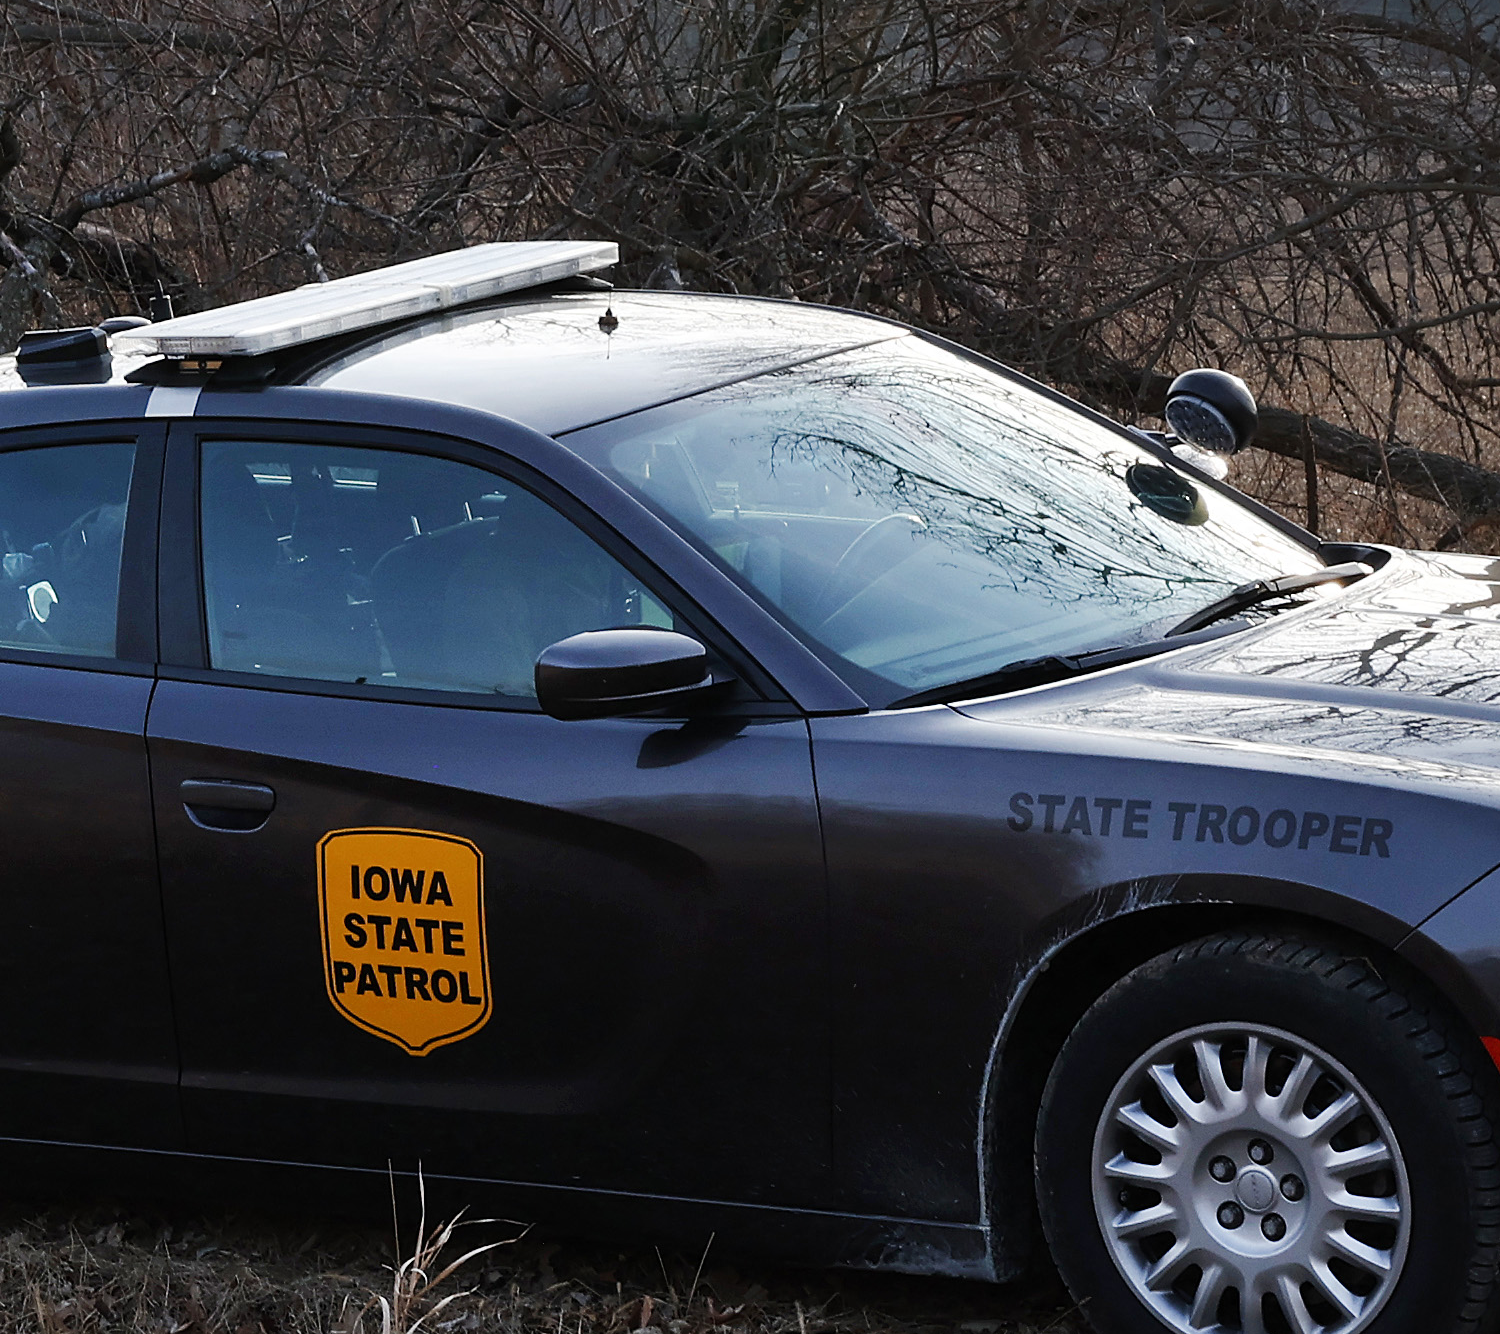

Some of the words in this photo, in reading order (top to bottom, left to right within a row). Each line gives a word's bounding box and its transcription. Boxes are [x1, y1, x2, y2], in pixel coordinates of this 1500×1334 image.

[1006, 791, 1152, 839] STATE
[1167, 801, 1394, 859] TROOPER
[350, 864, 454, 907] IOWA
[343, 912, 466, 957] STATE
[332, 960, 482, 1006] PATROL
